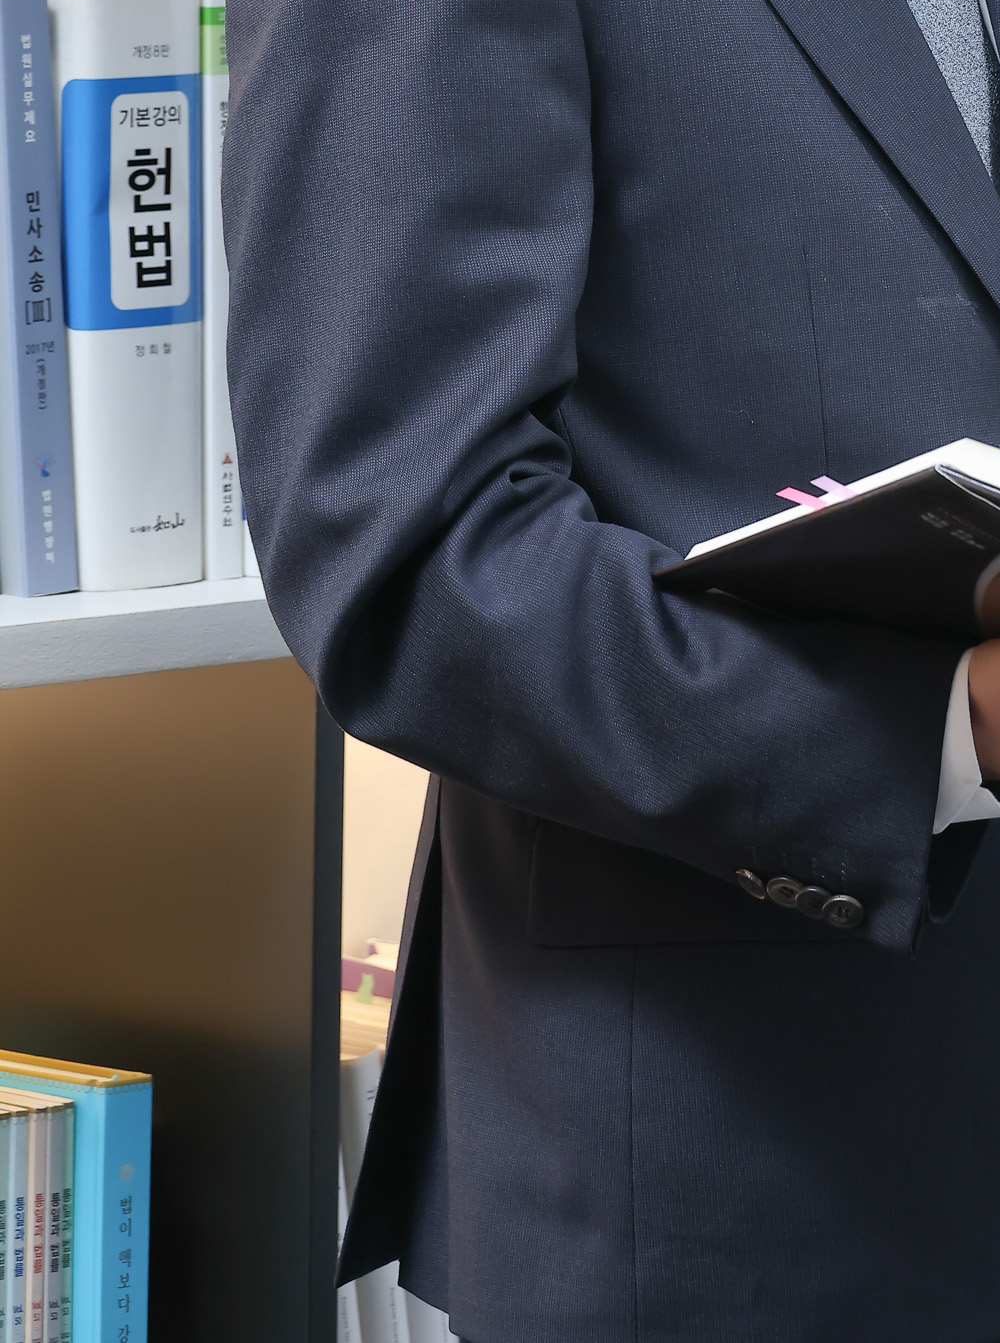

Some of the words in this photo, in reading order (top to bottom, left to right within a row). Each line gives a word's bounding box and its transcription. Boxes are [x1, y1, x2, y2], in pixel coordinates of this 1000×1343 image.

[20, 34, 37, 144] 법원실무제요
[118, 105, 181, 128] 기본강의
[26, 190, 45, 294] 민사소송
[127, 146, 172, 288] 헌법
[25, 340, 55, 355] 2017년
[118, 1195, 133, 1238] 법이
